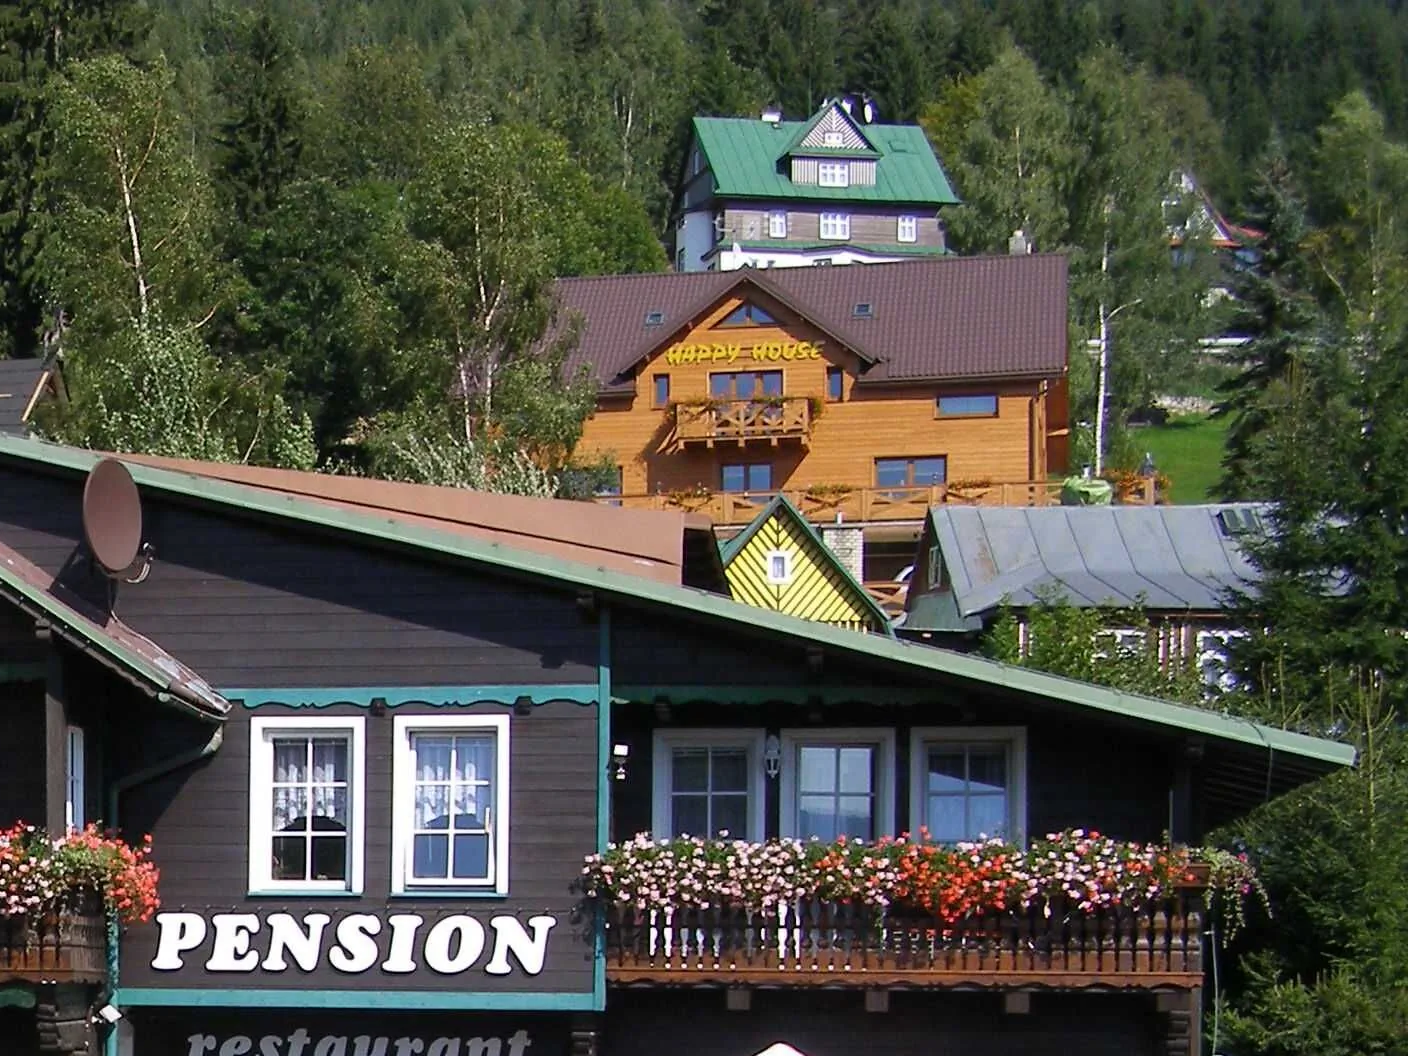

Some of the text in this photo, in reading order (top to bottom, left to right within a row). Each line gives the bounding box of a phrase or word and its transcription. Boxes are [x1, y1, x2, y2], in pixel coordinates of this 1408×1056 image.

[666, 340, 826, 364] HAPPY HOUSE
[151, 912, 558, 975] PENSION
